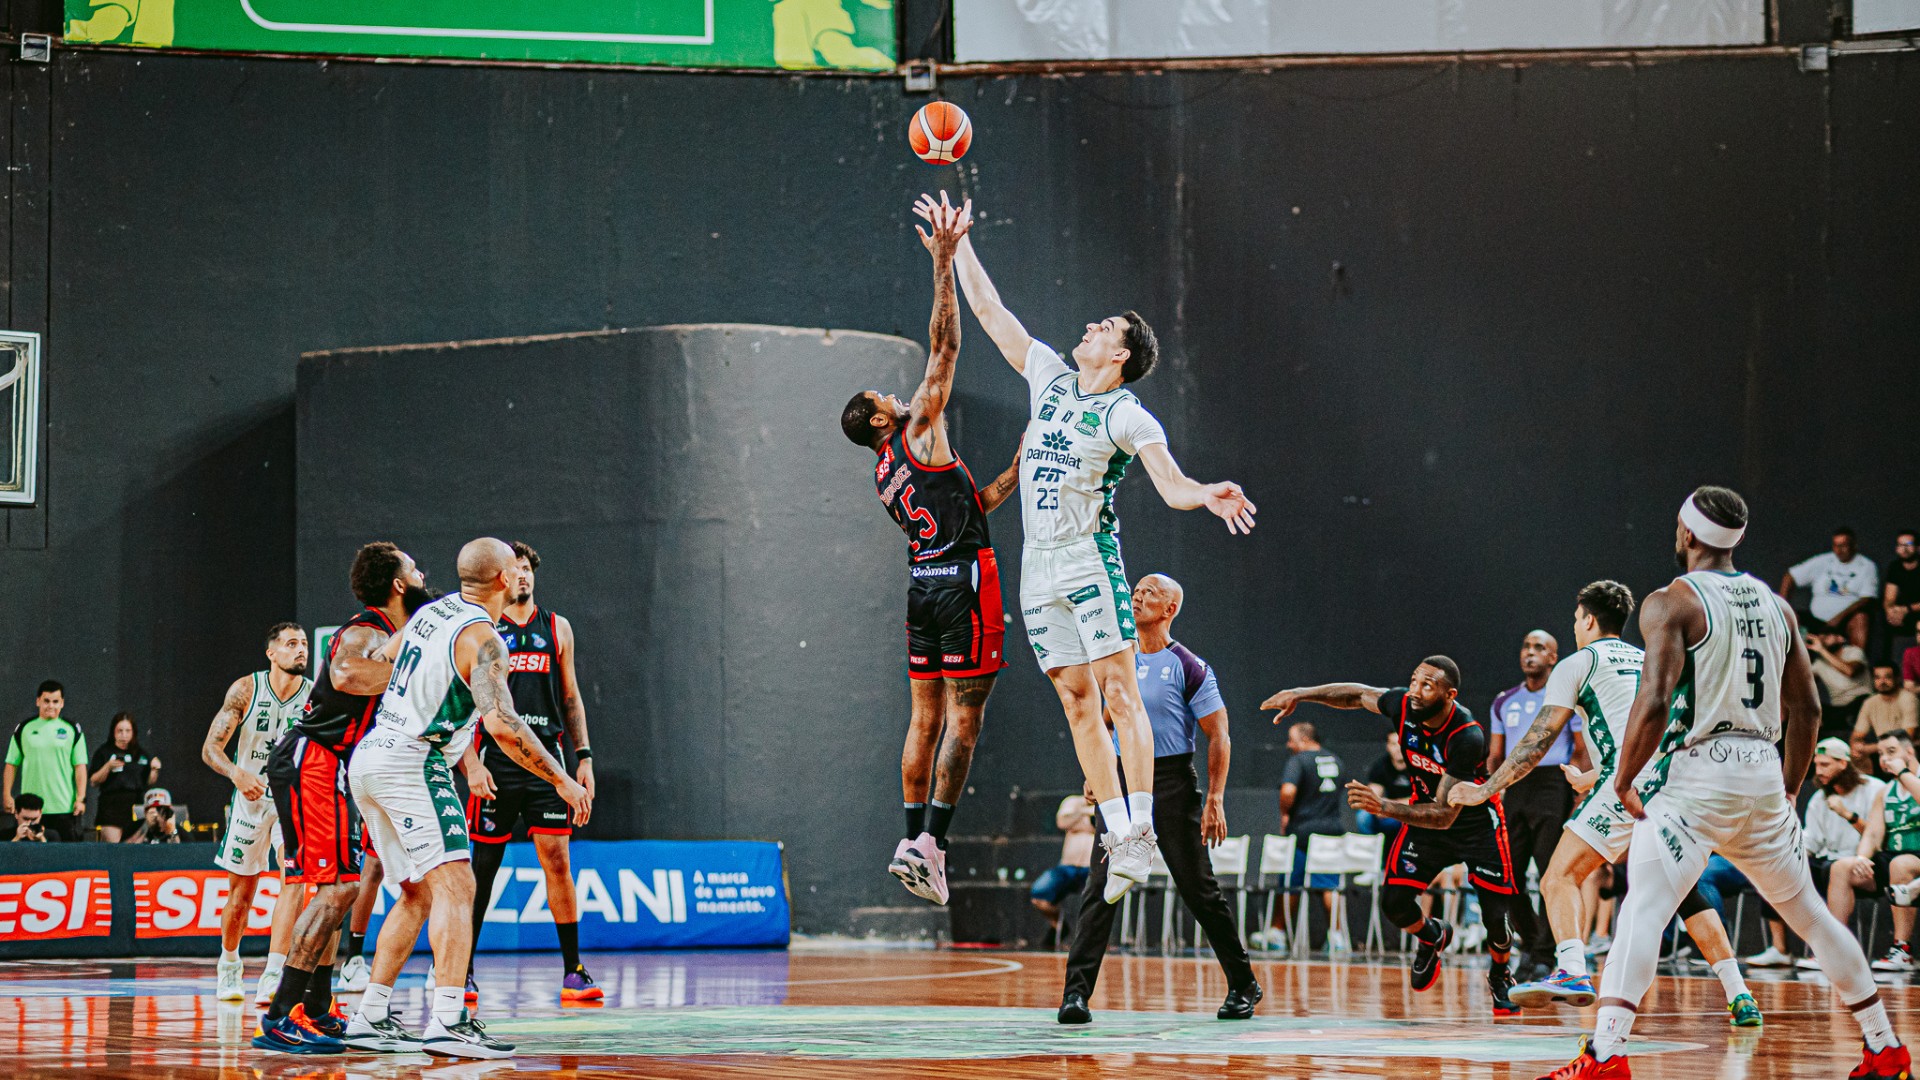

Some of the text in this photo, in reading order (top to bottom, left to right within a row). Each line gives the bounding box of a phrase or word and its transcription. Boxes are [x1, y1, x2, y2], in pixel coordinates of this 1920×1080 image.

[1026, 448, 1082, 470] parmalat
[1036, 487, 1059, 510] 23
[911, 566, 959, 577] Unimed
[410, 617, 438, 641] ALEX
[388, 640, 422, 698] 10
[508, 654, 546, 672] SESI
[943, 655, 962, 663] SESI
[1741, 648, 1764, 710] 3
[693, 869, 749, 885] A marca
[715, 886, 738, 899] um
